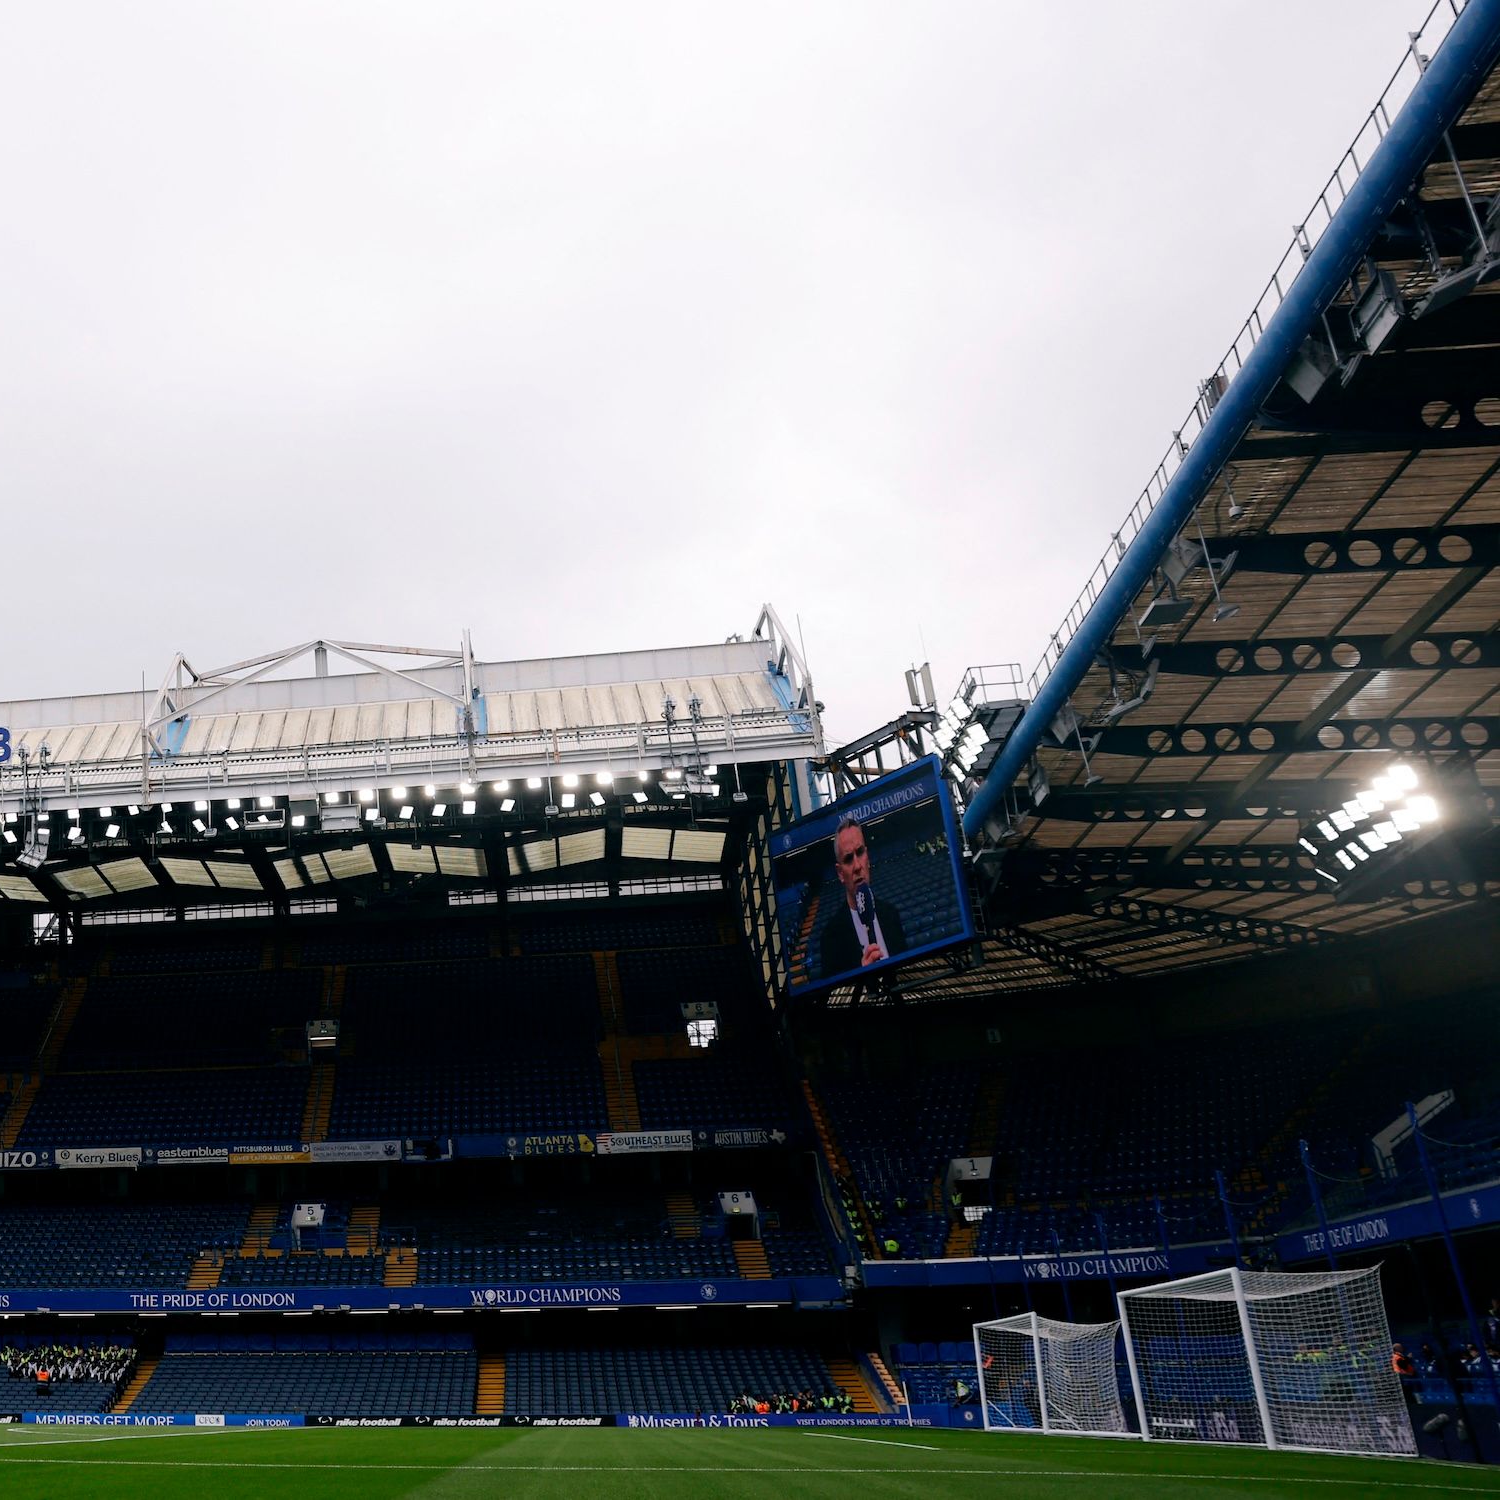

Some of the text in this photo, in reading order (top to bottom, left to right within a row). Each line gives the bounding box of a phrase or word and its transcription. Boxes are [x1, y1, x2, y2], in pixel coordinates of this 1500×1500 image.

[870, 783, 925, 814] CHAMPIONS
[525, 1135, 575, 1145] ATLANTA
[611, 1135, 691, 1146] SOUTHEAST BLUES
[715, 1130, 768, 1145] AUSTIN BLUES
[157, 1147, 228, 1157] easternblues
[525, 1145, 575, 1155] BLUES
[76, 1153, 138, 1164] Kerry Blues
[968, 1159, 977, 1171] 1
[732, 1194, 739, 1203] 6
[308, 1206, 314, 1215] 5
[1303, 1218, 1389, 1252] THE PDE OF LONDON
[130, 1293, 295, 1307] THE PRIDE OF LONDON
[470, 1288, 621, 1303] WORLD CHAMPIONS
[35, 1415, 174, 1425] MEMBERS GET MORE
[335, 1418, 402, 1426] nike football
[433, 1418, 501, 1426] nike football
[533, 1418, 557, 1426] nike
[639, 1415, 769, 1427] Museum & Tours
